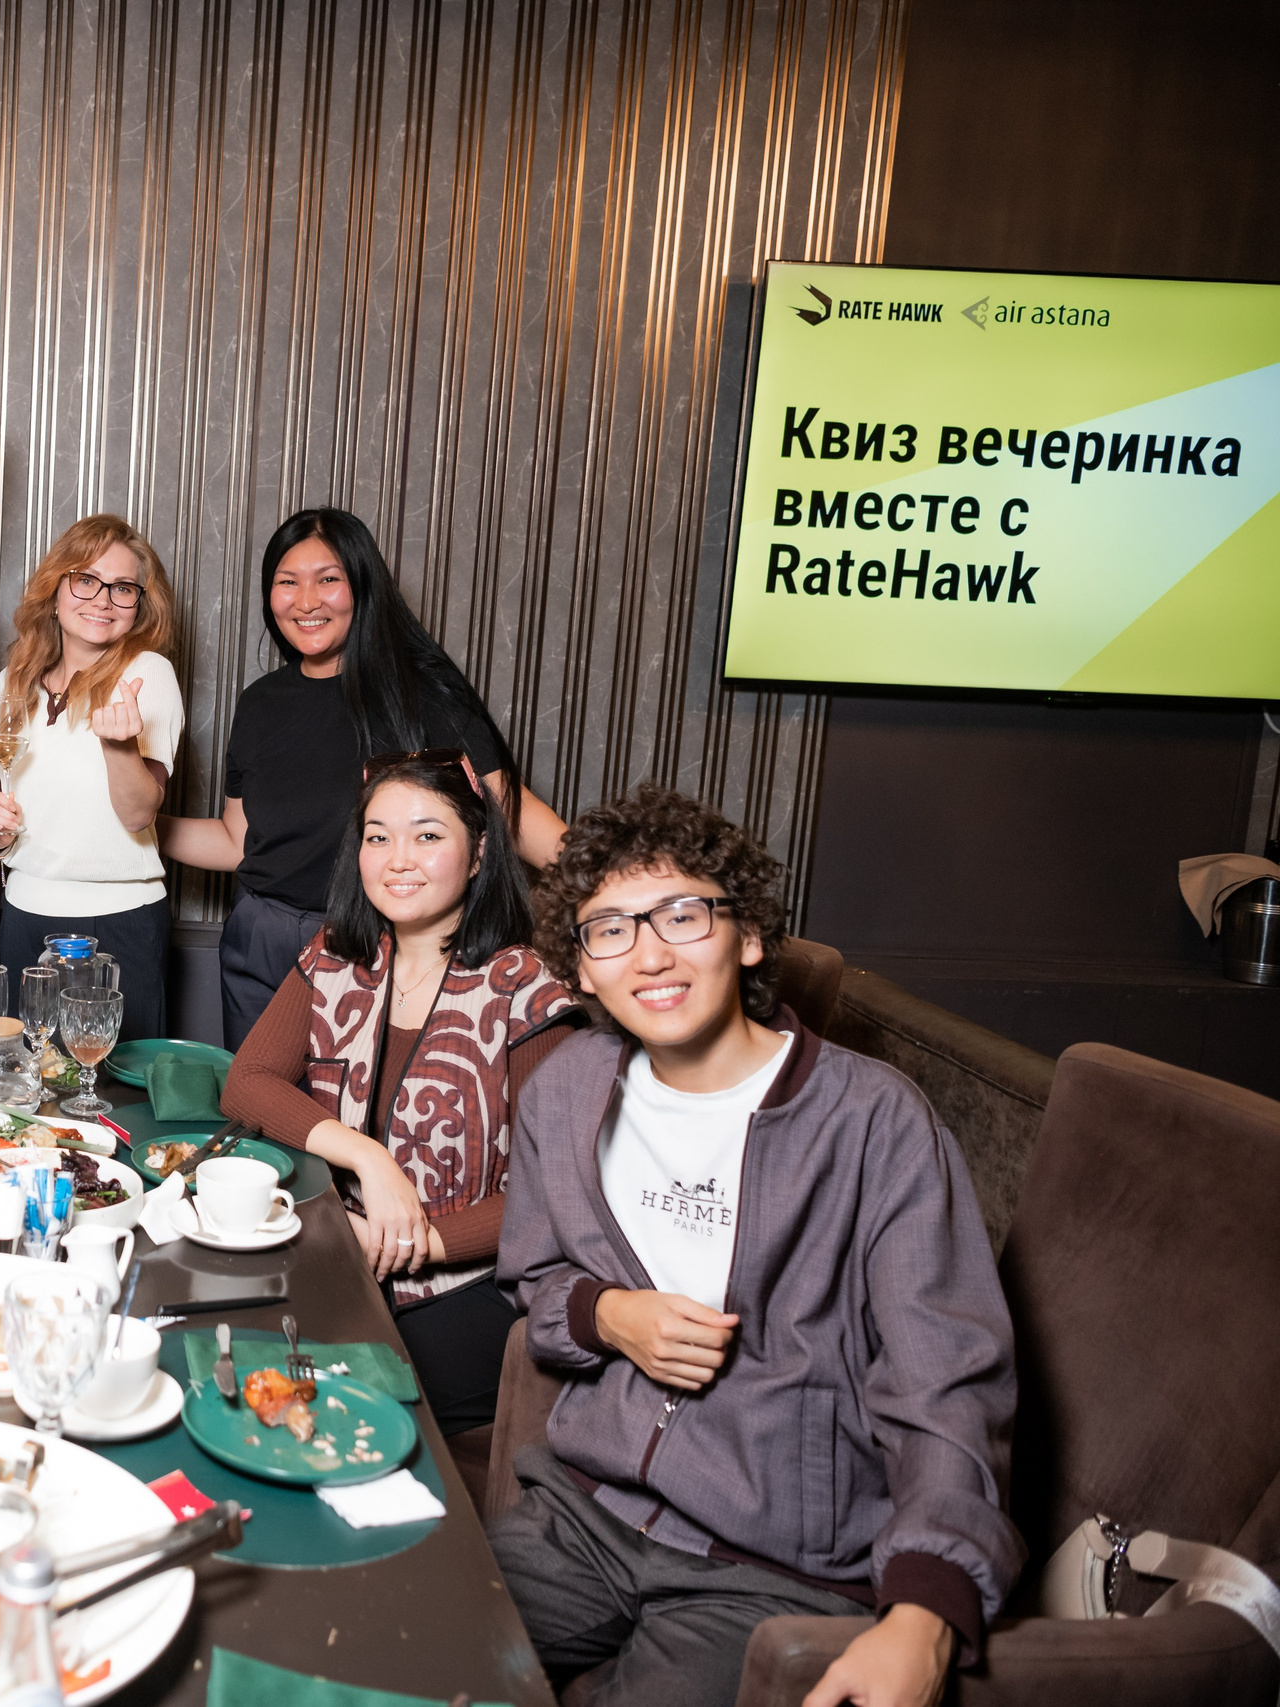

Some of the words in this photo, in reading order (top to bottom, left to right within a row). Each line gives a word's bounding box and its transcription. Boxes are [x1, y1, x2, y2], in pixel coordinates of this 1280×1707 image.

[838, 300, 883, 320] RATE
[888, 302, 944, 323] HAWK
[994, 300, 1027, 324] air
[1030, 304, 1111, 327] astana
[780, 406, 918, 463] Квиз
[937, 424, 1243, 485] вечеринка
[772, 488, 981, 535] вместе
[1000, 497, 1030, 536] с
[765, 543, 1041, 604] RateHawk
[640, 1189, 733, 1227] HERMÈ
[673, 1218, 714, 1237] PARIS
